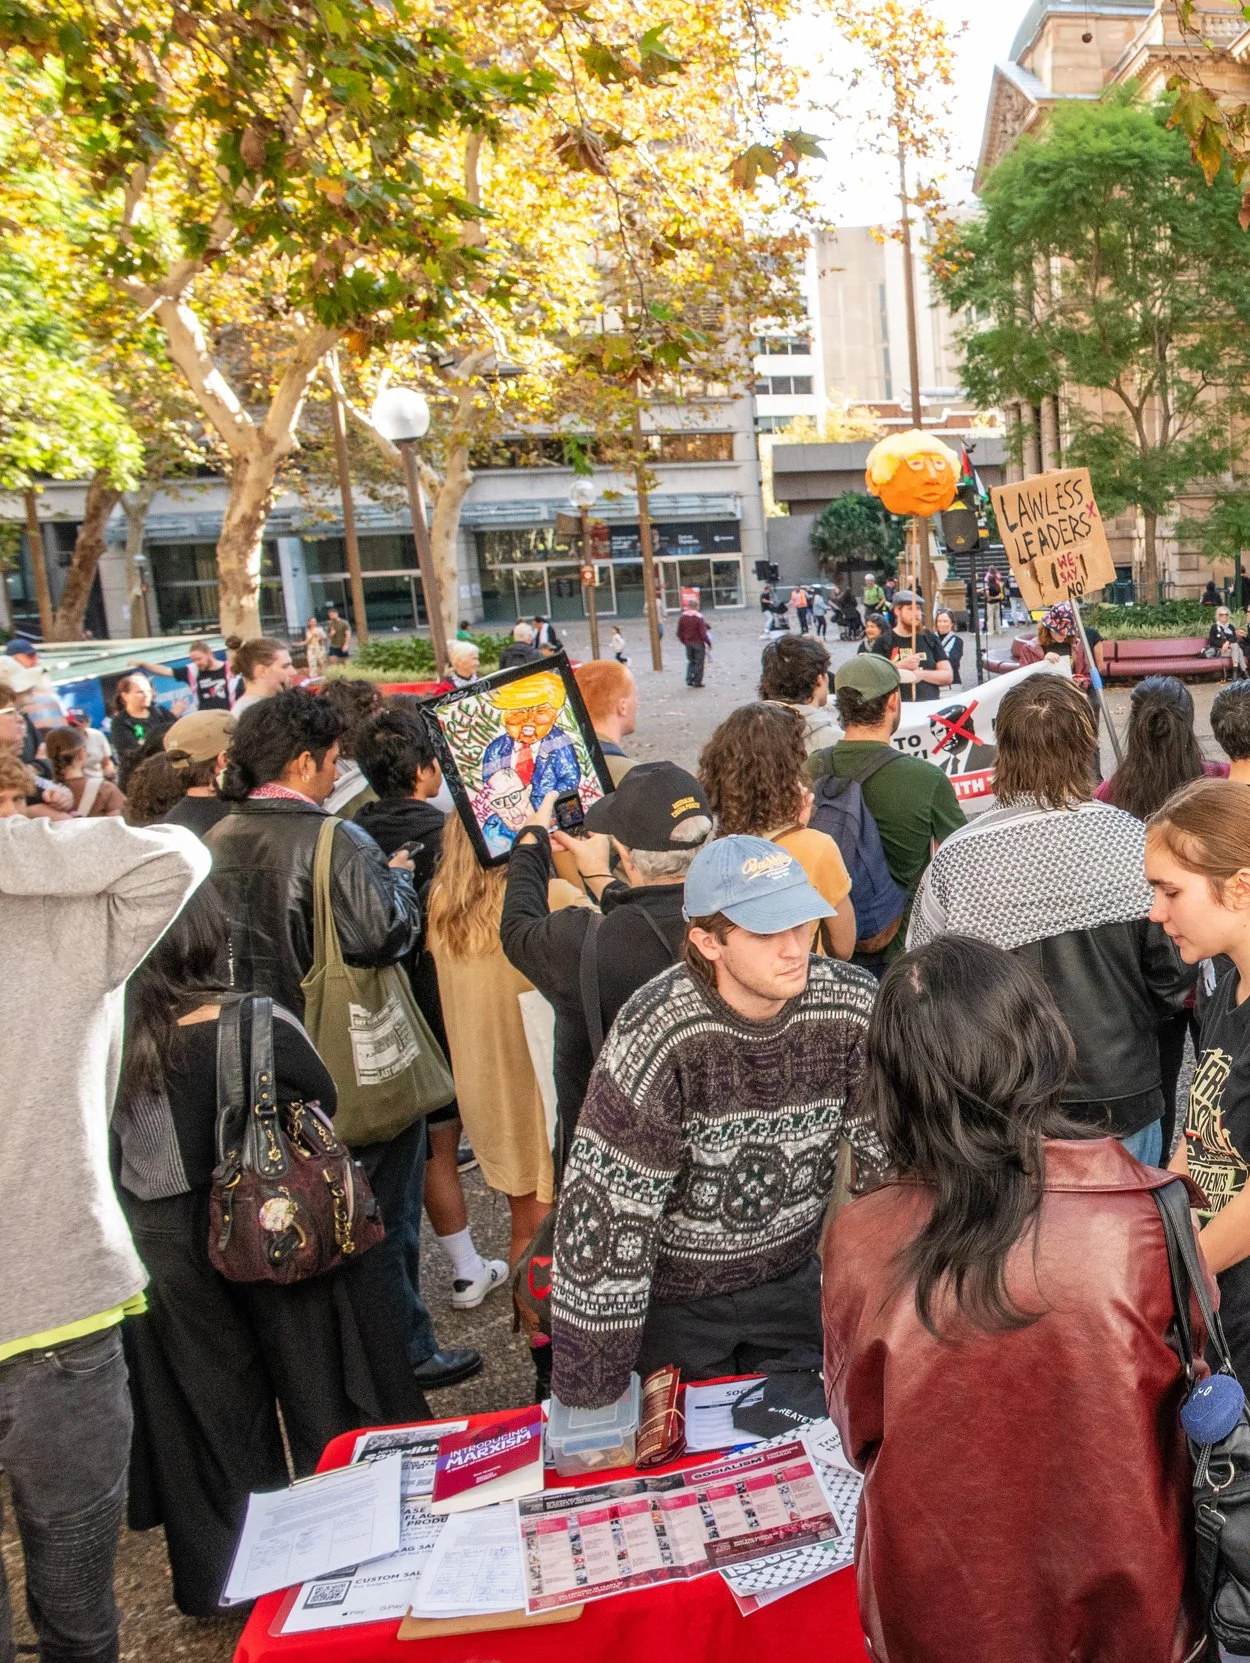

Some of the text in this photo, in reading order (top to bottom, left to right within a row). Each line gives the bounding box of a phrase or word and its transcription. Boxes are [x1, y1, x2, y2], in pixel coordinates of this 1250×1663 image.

[1000, 479, 1083, 533] LAWLESS
[1015, 512, 1091, 564] LEADERS
[1057, 552, 1075, 569] WE
[1059, 567, 1078, 583] SAY
[1067, 576, 1087, 598] NO!
[440, 701, 479, 750] FREE
[894, 735, 921, 750] TO
[952, 777, 985, 796] ITH
[1189, 1169, 1228, 1192] TUDENTS
[445, 1430, 532, 1470] MARXISM
[450, 1426, 528, 1457] INTRODUCING
[694, 1457, 763, 1479] SOCIALISM
[407, 1516, 448, 1527] PRODU
[355, 1573, 400, 1585] CUSTOM
[403, 1570, 423, 1578] SAL
